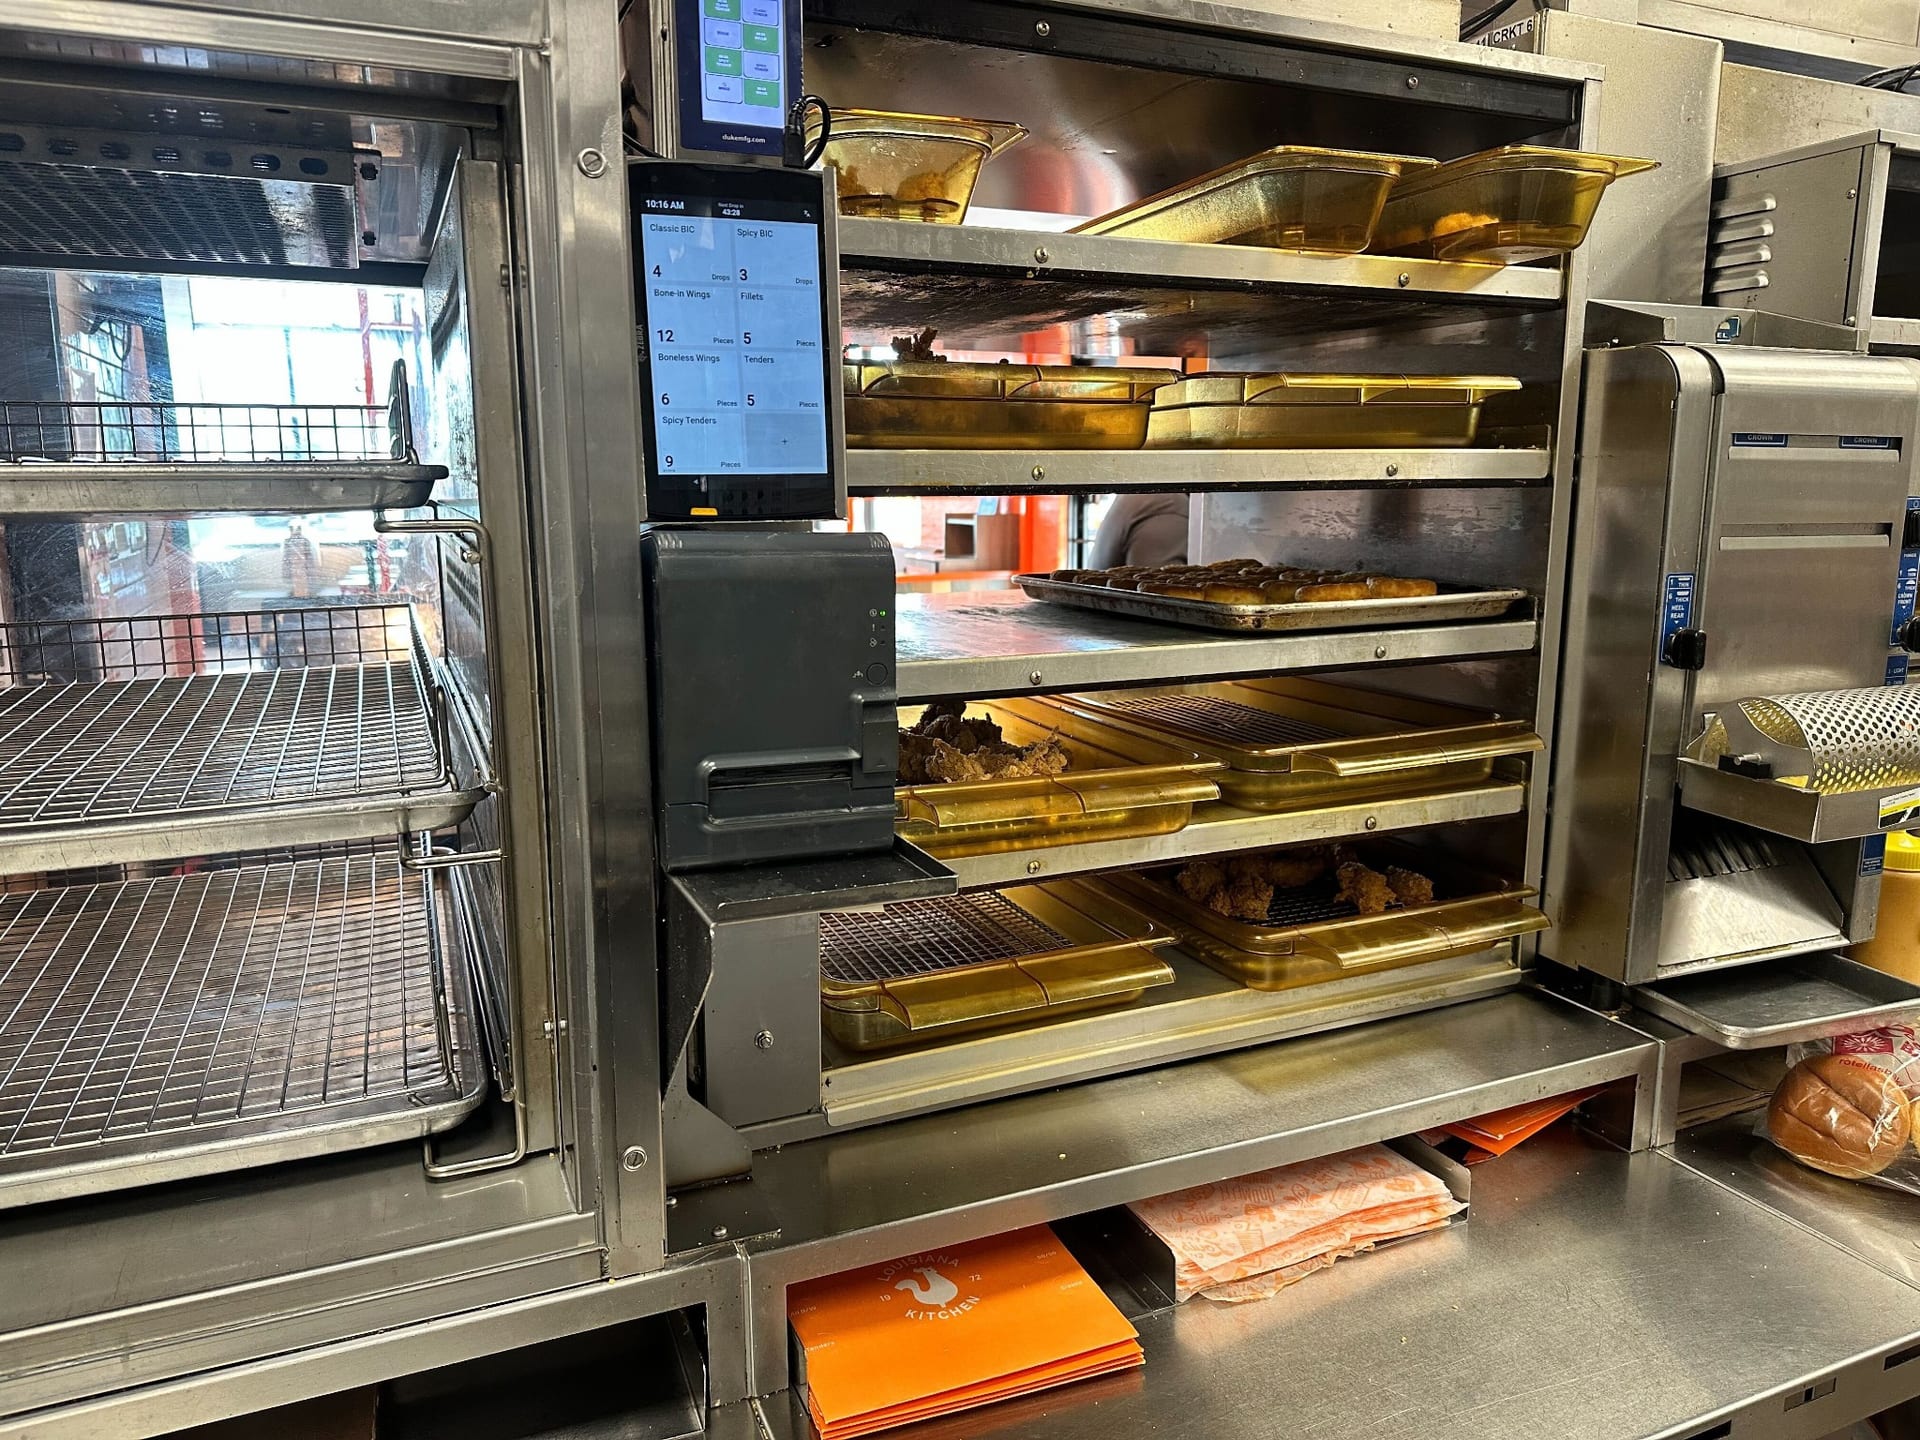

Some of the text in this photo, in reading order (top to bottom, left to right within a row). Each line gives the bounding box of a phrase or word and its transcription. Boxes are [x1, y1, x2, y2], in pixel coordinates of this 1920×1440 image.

[1493, 22, 1524, 44] CRKT
[1526, 19, 1533, 32] 6
[722, 133, 766, 143] dukemfg.com
[645, 200, 684, 209] 10:16 AM
[650, 223, 695, 233] Classic BIC
[737, 228, 773, 238] Spicy BIC
[652, 265, 662, 277] 4
[739, 268, 748, 281] 3
[711, 273, 730, 282] Drops
[795, 277, 813, 285] Drops
[686, 289, 711, 300] Wings
[740, 291, 764, 301] Fillets
[657, 329, 675, 343] 12
[712, 336, 734, 344] Pieces
[743, 331, 752, 345] 5
[796, 339, 816, 347] Pieces
[658, 353, 721, 364] Boneless Wings
[744, 355, 775, 364] Tenders
[661, 392, 670, 406] 6
[716, 399, 738, 407] Pieces
[746, 393, 755, 407] 5
[799, 400, 819, 408] Pieces
[662, 416, 717, 426] Spicy Tenders
[1747, 433, 1774, 442] CROWN
[1853, 436, 1879, 444] CROWN
[665, 455, 674, 468] 9
[1668, 592, 1673, 600] 6
[878, 1254, 960, 1282] LOUISIANA
[880, 1273, 982, 1302] 19 72
[905, 1295, 981, 1321] KITCHEN
